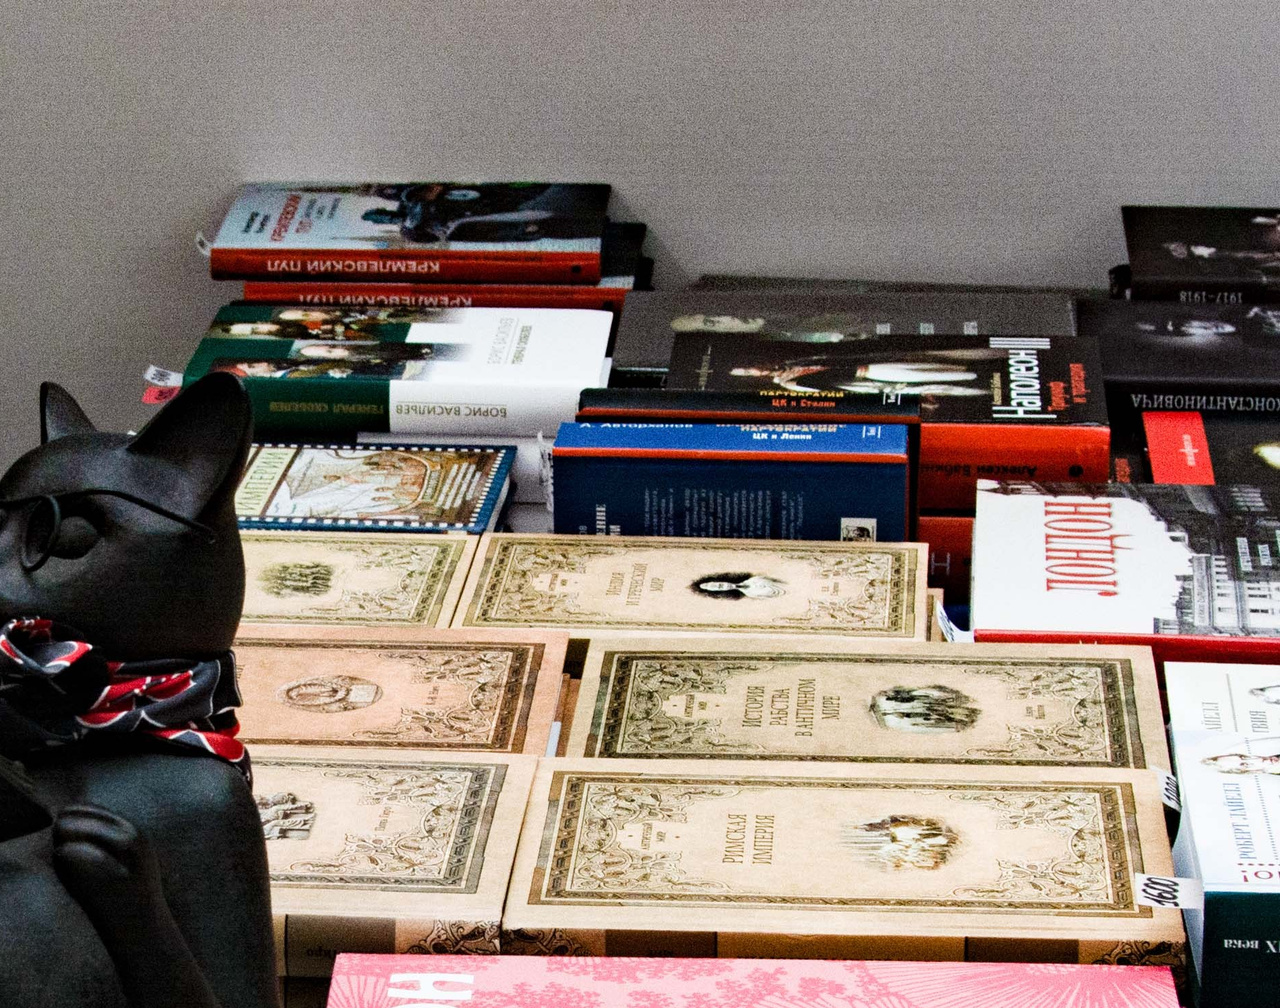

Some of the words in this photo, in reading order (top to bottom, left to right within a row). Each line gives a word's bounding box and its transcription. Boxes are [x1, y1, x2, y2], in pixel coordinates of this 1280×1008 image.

[267, 260, 302, 272] ПУЛ
[306, 260, 441, 275] КРЕМЛЕВСКИЙ
[992, 350, 1058, 419] Наполеон
[395, 404, 461, 417] ВАСИЛЬЕВ
[464, 406, 508, 418] БОРИС
[752, 432, 768, 441] ЦК
[780, 432, 812, 440] Ленин
[1044, 501, 1135, 597] ЛОНДОН
[741, 685, 766, 728] ИСТОРИЯ
[771, 687, 791, 727] РАБСТВА
[794, 677, 817, 730] АНТИЧНОМ
[821, 694, 841, 721] МИРЕ
[794, 730, 812, 738] В
[722, 813, 748, 865] РИМСКАЯ
[752, 814, 776, 866] ИМПЕРИЯ
[1232, 821, 1258, 861] РОБЕРТ
[1141, 875, 1180, 908] 1600
[1223, 939, 1260, 950] века
